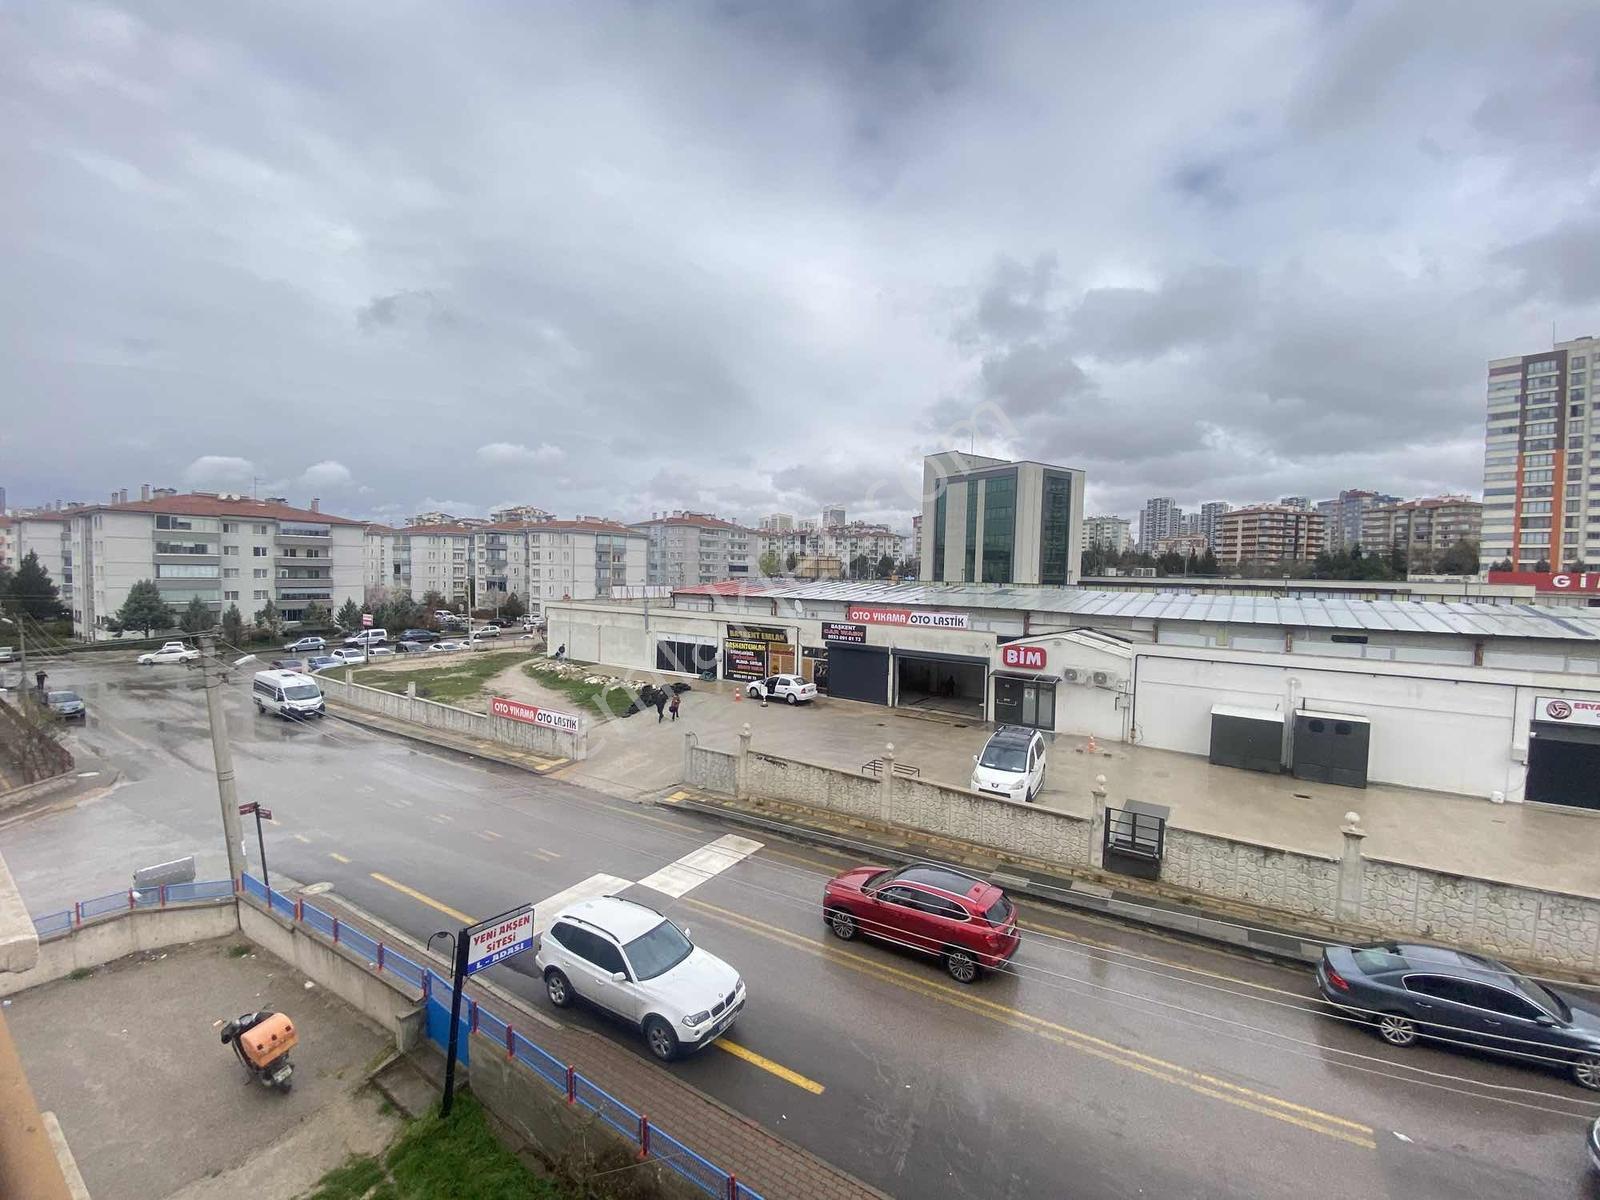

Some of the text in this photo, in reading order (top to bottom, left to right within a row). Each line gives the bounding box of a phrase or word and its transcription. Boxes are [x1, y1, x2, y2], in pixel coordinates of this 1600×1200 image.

[851, 611, 964, 626] OTO YIKAMA OTO LASTİK
[1007, 647, 1041, 666] BİM
[494, 703, 577, 730] OTO YIKAMA OTO LASTİK
[474, 915, 530, 945] YENİ AKŞEN
[486, 932, 516, 953] SİTESİ
[492, 943, 524, 962] ADASI
